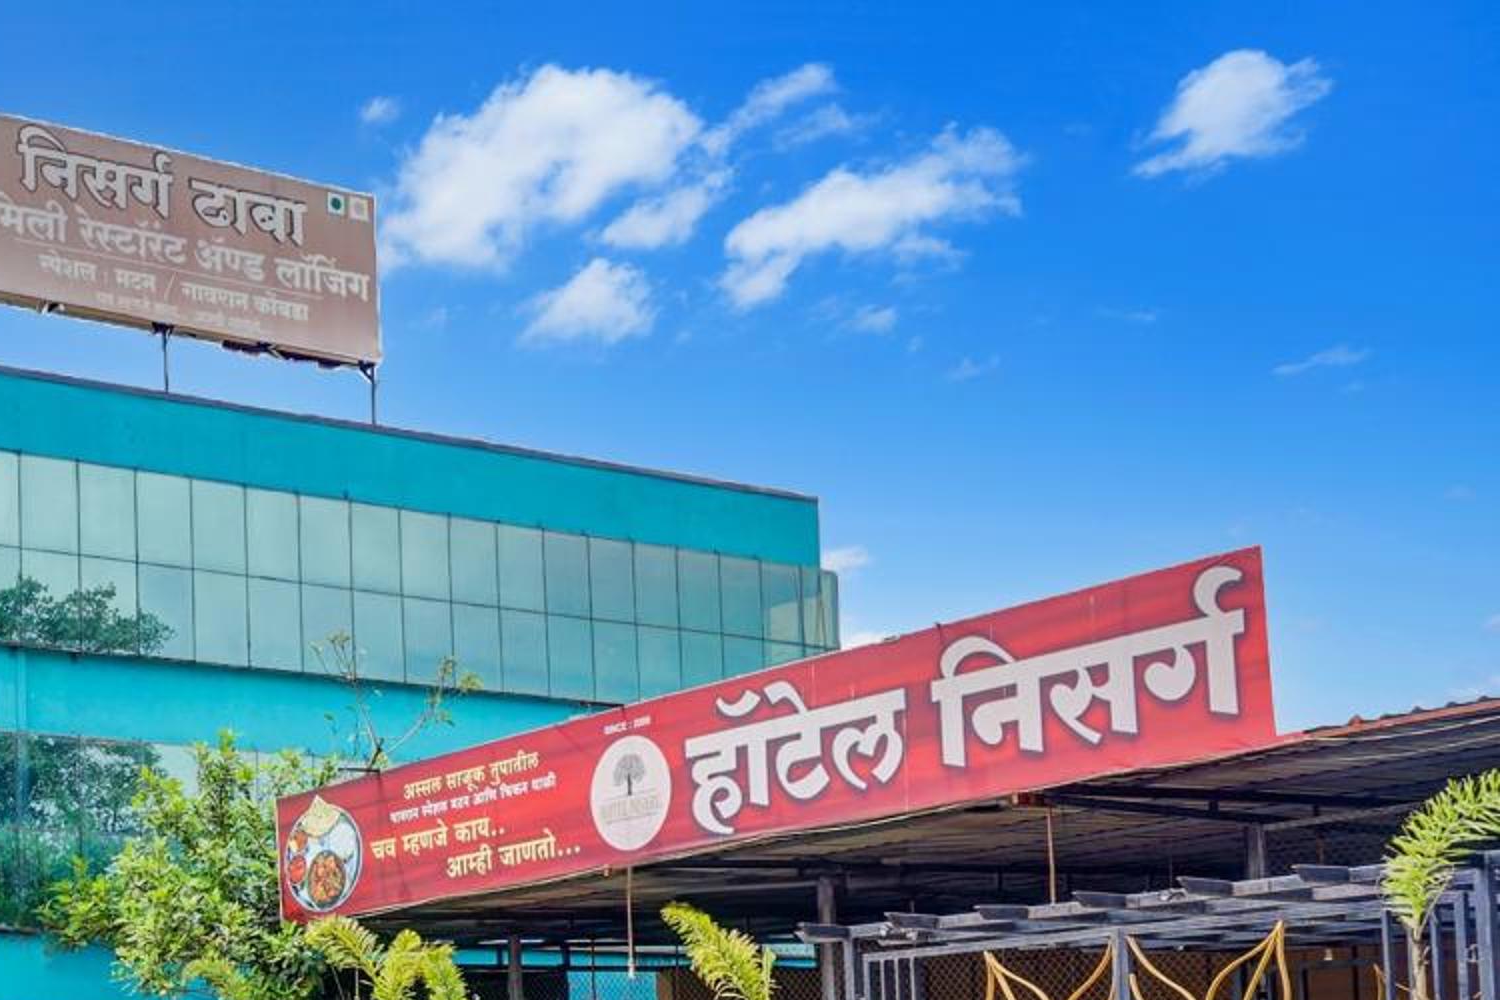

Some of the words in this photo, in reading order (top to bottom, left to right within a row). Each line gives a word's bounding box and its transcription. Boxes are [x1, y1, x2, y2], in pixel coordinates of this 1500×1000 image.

[17, 124, 173, 220] निसर्ग
[189, 176, 308, 247] ढाबा
[684, 681, 906, 835] हॉटेल
[931, 565, 1246, 768] निसर्ग
